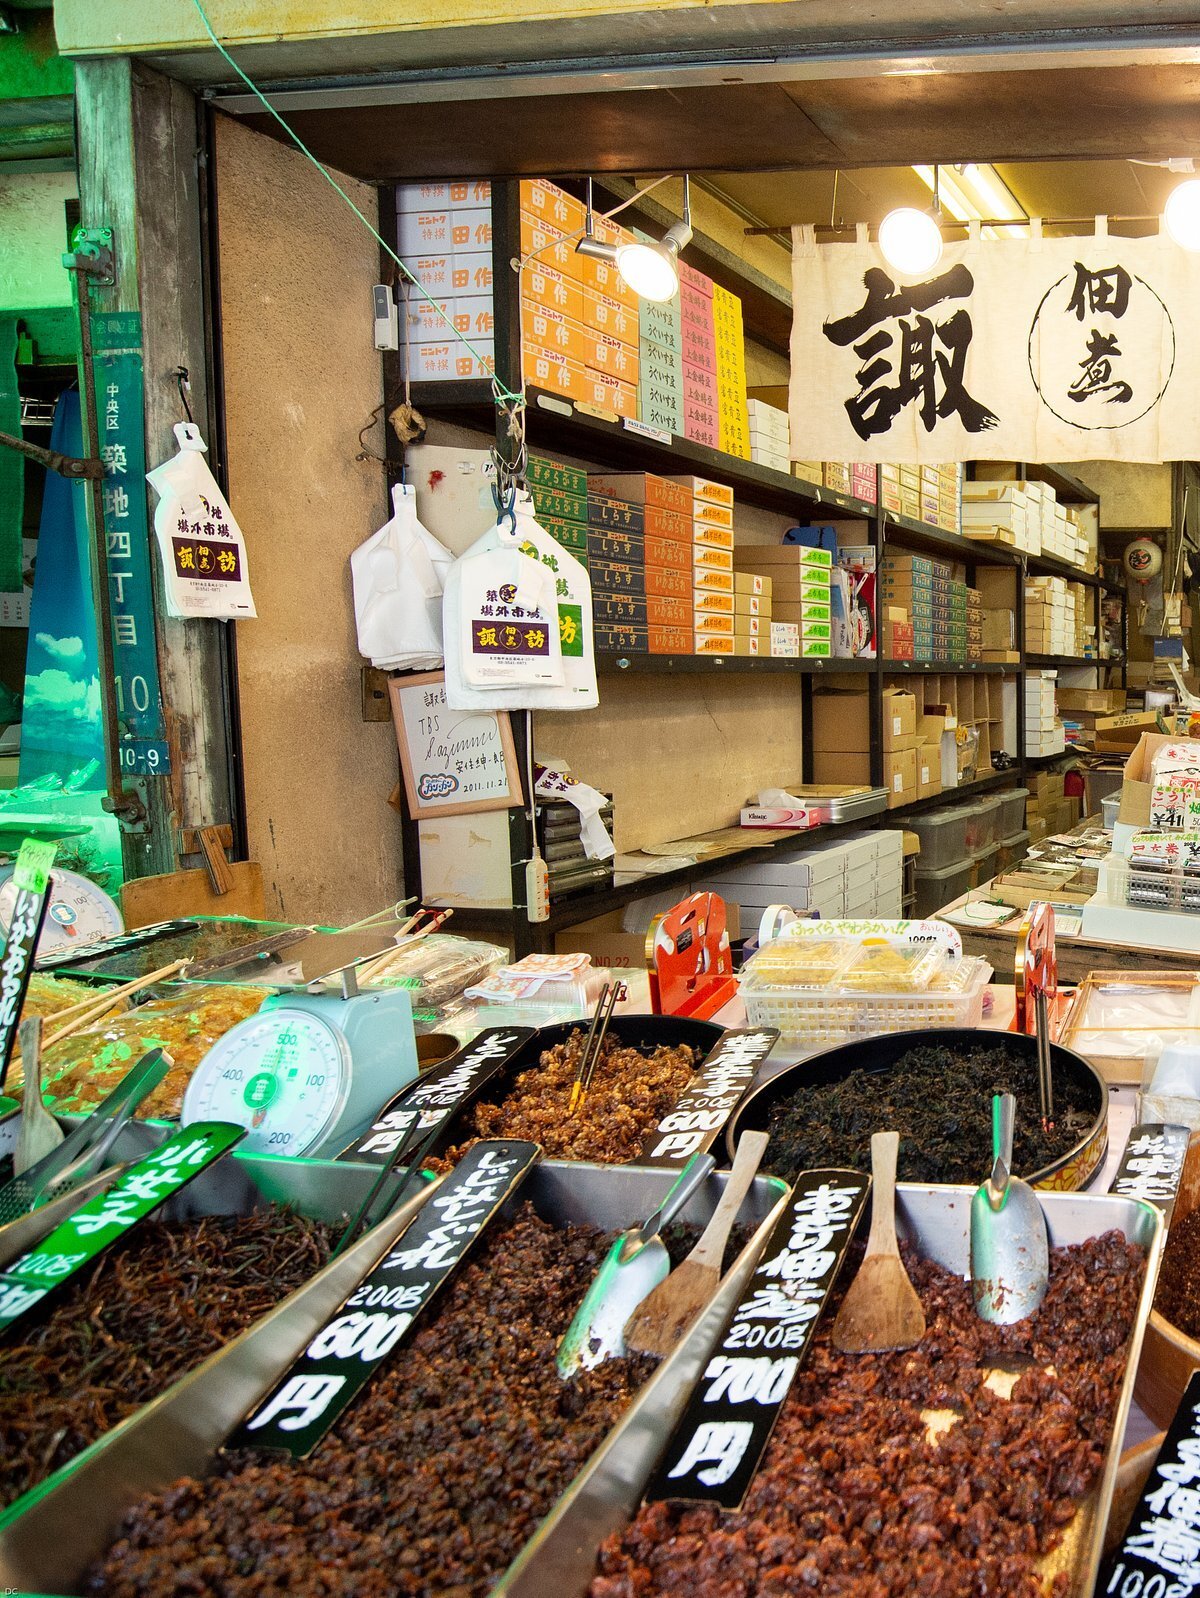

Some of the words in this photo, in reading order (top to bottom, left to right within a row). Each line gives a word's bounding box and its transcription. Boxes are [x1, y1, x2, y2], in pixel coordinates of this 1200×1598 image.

[646, 303, 674, 328] うぐいす豆
[648, 323, 675, 348] うぐいす豆
[648, 344, 675, 368] うぐいす豆
[823, 263, 1000, 441] 諏
[1066, 262, 1134, 404] 佃煮
[649, 365, 676, 389] うぐいす豆
[106, 382, 120, 430] 中央区
[649, 387, 677, 410] うぐいす豆
[650, 409, 677, 431] うぐいす豆
[601, 506, 632, 524] しらす
[102, 443, 138, 646] 築地四丁目
[601, 539, 632, 554] しらす
[217, 551, 237, 573] 訪
[604, 570, 633, 585] しらす
[606, 601, 636, 615] しらす
[524, 630, 546, 649] 訪
[608, 633, 637, 646] しらす
[114, 676, 150, 712] 10
[418, 715, 439, 735] TBS
[118, 748, 161, 768] 10-9
[790, 921, 834, 936] ふっくら
[676, 1094, 740, 1110] 200g
[657, 1108, 731, 1133] 600
[357, 1130, 406, 1154] 円
[651, 1132, 708, 1159] 円
[71, 1138, 215, 1237] 小女子
[6, 1252, 85, 1277] 100g
[734, 1184, 861, 1326] あさり佃煮
[346, 1281, 431, 1310] 200g
[308, 1311, 413, 1362] 600
[723, 1321, 810, 1350] 200g
[702, 1355, 800, 1405] 700
[246, 1374, 347, 1432] 円
[667, 1421, 755, 1487] 円
